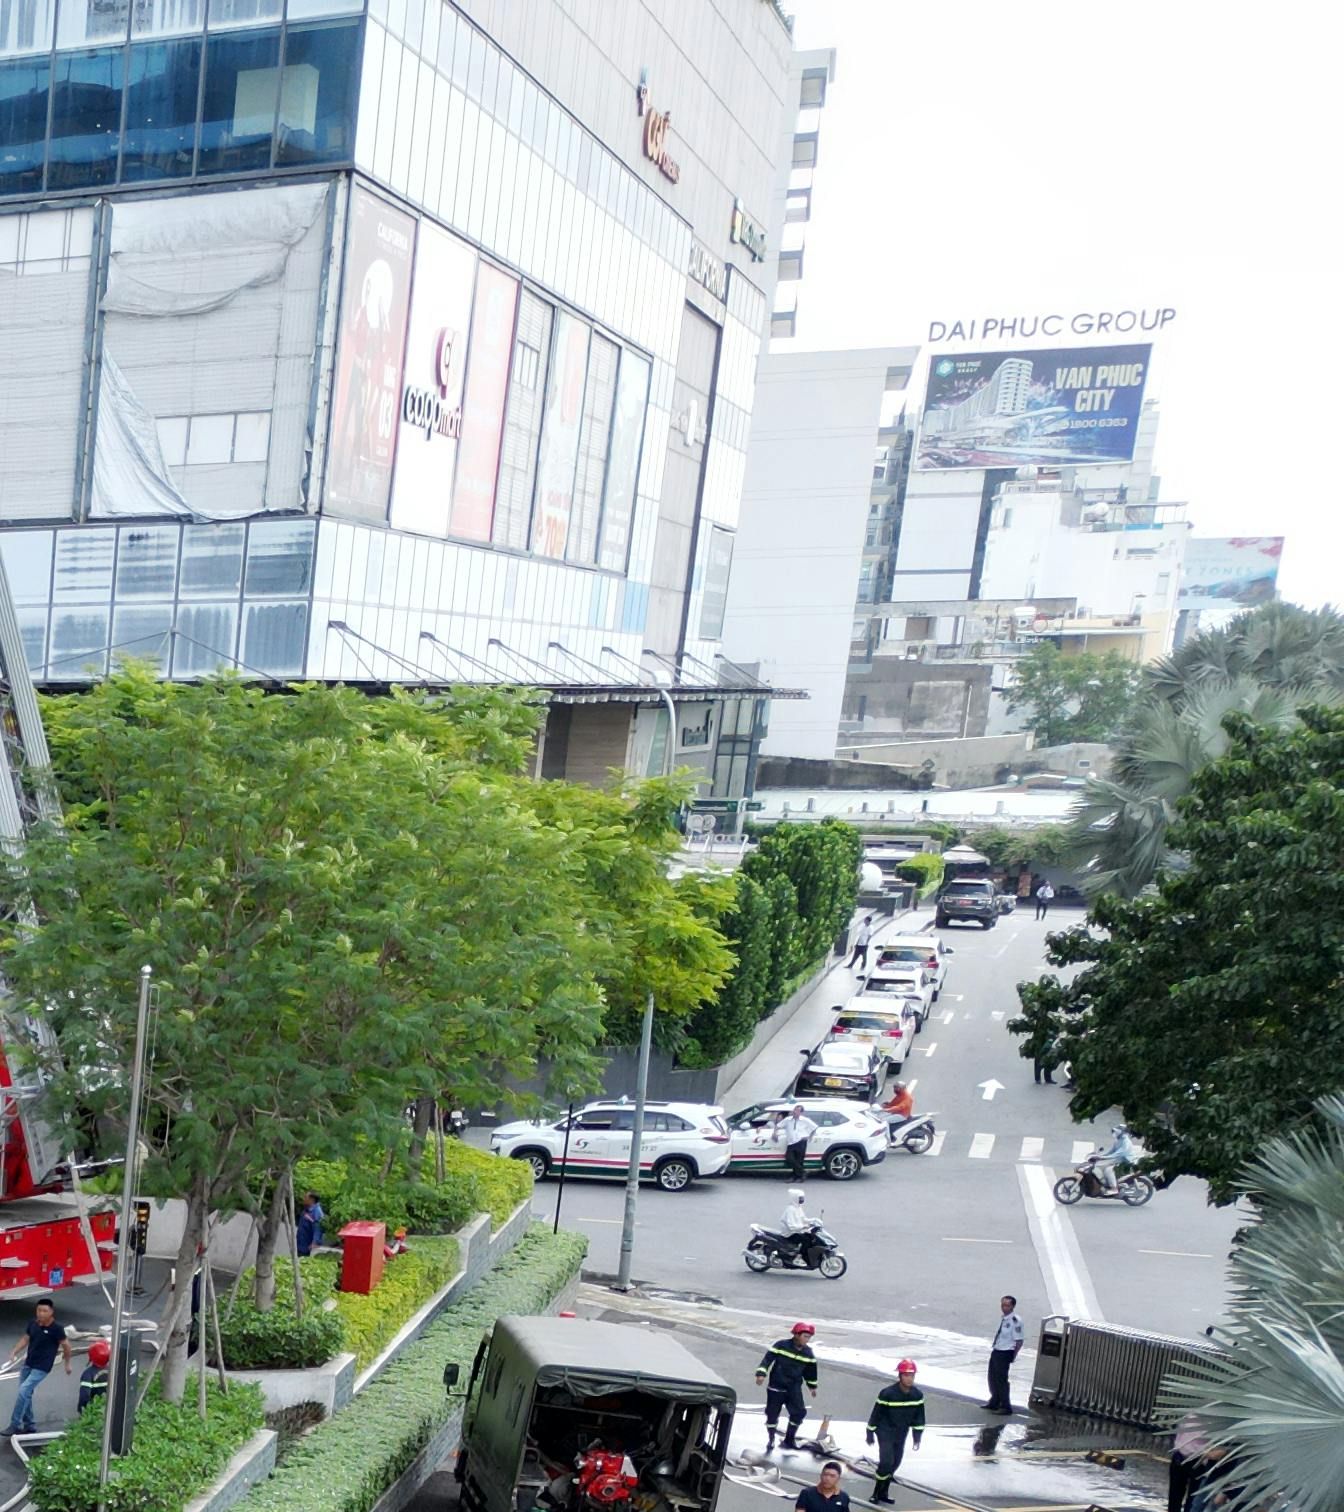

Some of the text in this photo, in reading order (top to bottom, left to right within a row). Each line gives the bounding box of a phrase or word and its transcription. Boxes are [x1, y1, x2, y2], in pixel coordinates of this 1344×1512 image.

[928, 308, 1177, 342] DAI PHUC GROUP
[1055, 363, 1144, 390] VAN PHUC
[1075, 388, 1116, 413] CITY
